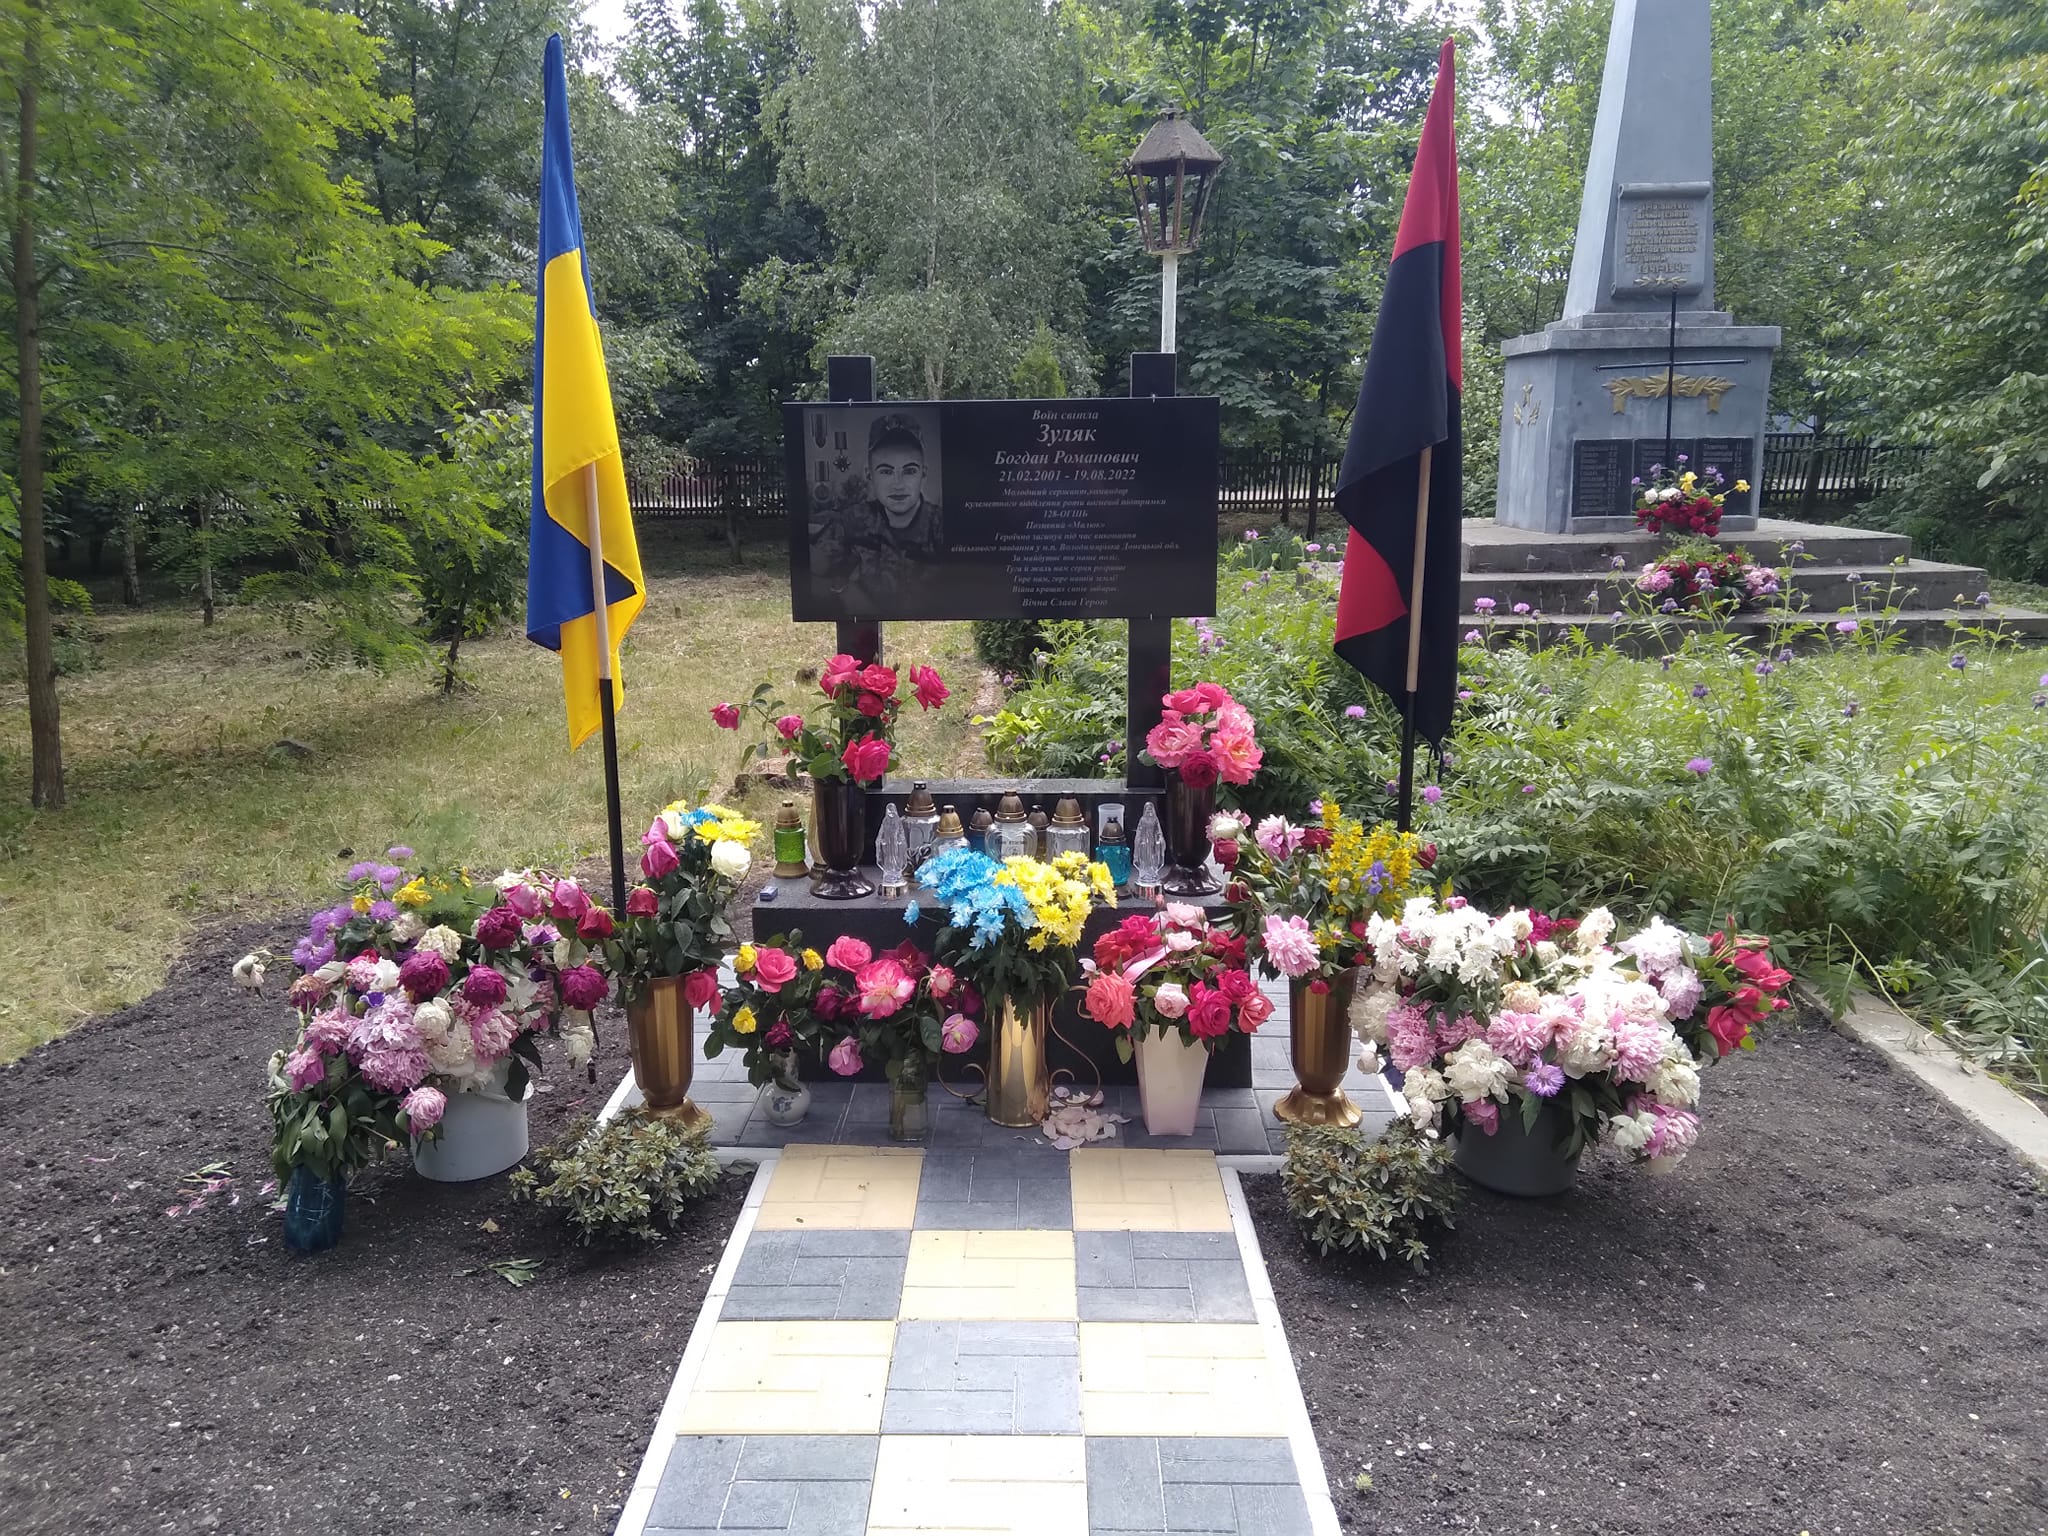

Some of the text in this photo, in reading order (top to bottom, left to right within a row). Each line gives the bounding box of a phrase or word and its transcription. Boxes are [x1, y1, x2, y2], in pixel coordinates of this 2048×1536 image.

[1032, 410, 1099, 420] Воїн світла
[1037, 424, 1096, 446] Зуляк
[994, 450, 1139, 465] Богдан Романович
[999, 470, 1061, 482] 21.02.2001
[1074, 469, 1136, 481] 19.08.2022
[1003, 488, 1048, 497] Молодший
[1022, 598, 1108, 608] Вічна Слава Герою
